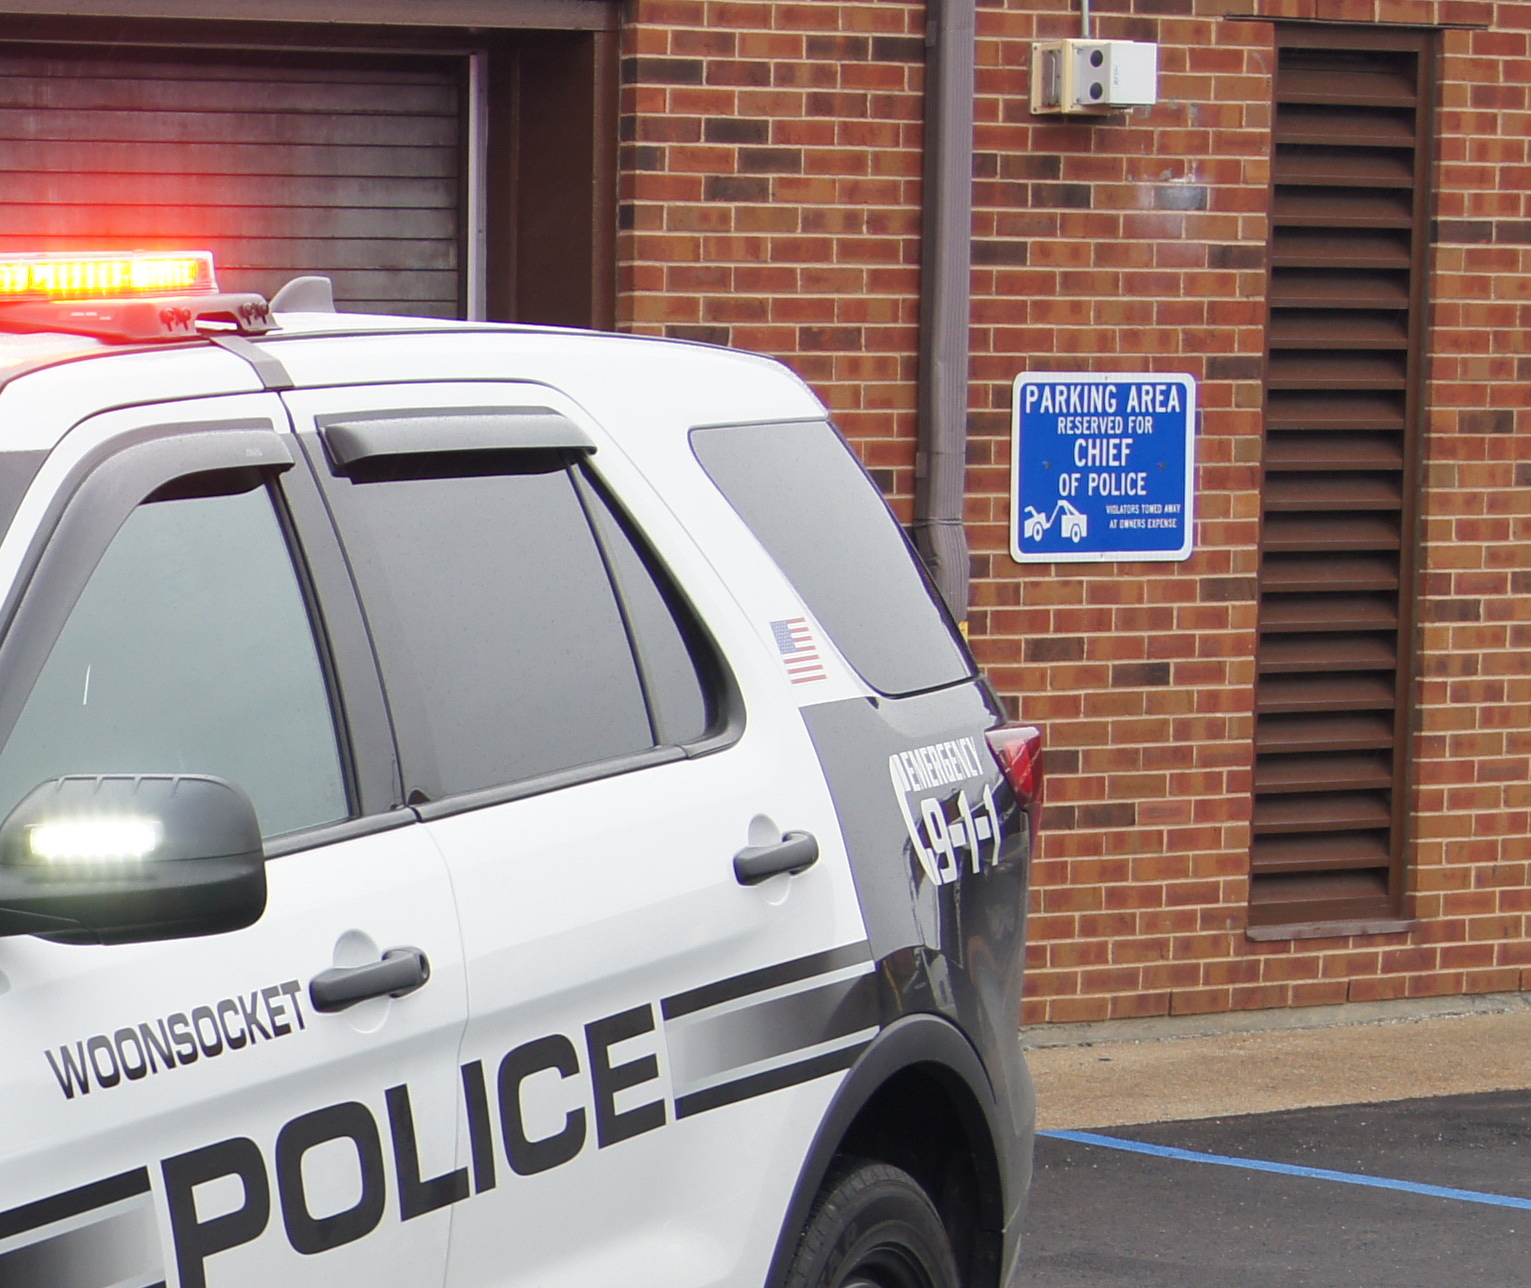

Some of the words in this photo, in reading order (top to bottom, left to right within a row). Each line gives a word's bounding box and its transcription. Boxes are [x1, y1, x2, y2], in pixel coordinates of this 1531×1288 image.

[1025, 385, 1117, 414] PARKING
[1126, 385, 1180, 413] AREA
[1057, 416, 1123, 434] RESERVED
[1128, 416, 1153, 434] FOR
[1074, 438, 1133, 467] CHIEF
[1059, 473, 1081, 496] OF
[1088, 472, 1147, 496] POLICE
[1106, 504, 1140, 514] VIOLATORS
[1141, 504, 1162, 514] TOWED
[1109, 519, 1118, 528] AT
[900, 736, 984, 792] EMERGENCY
[921, 784, 1001, 884] 9-1-1
[44, 979, 306, 1100] WOONSOCKET
